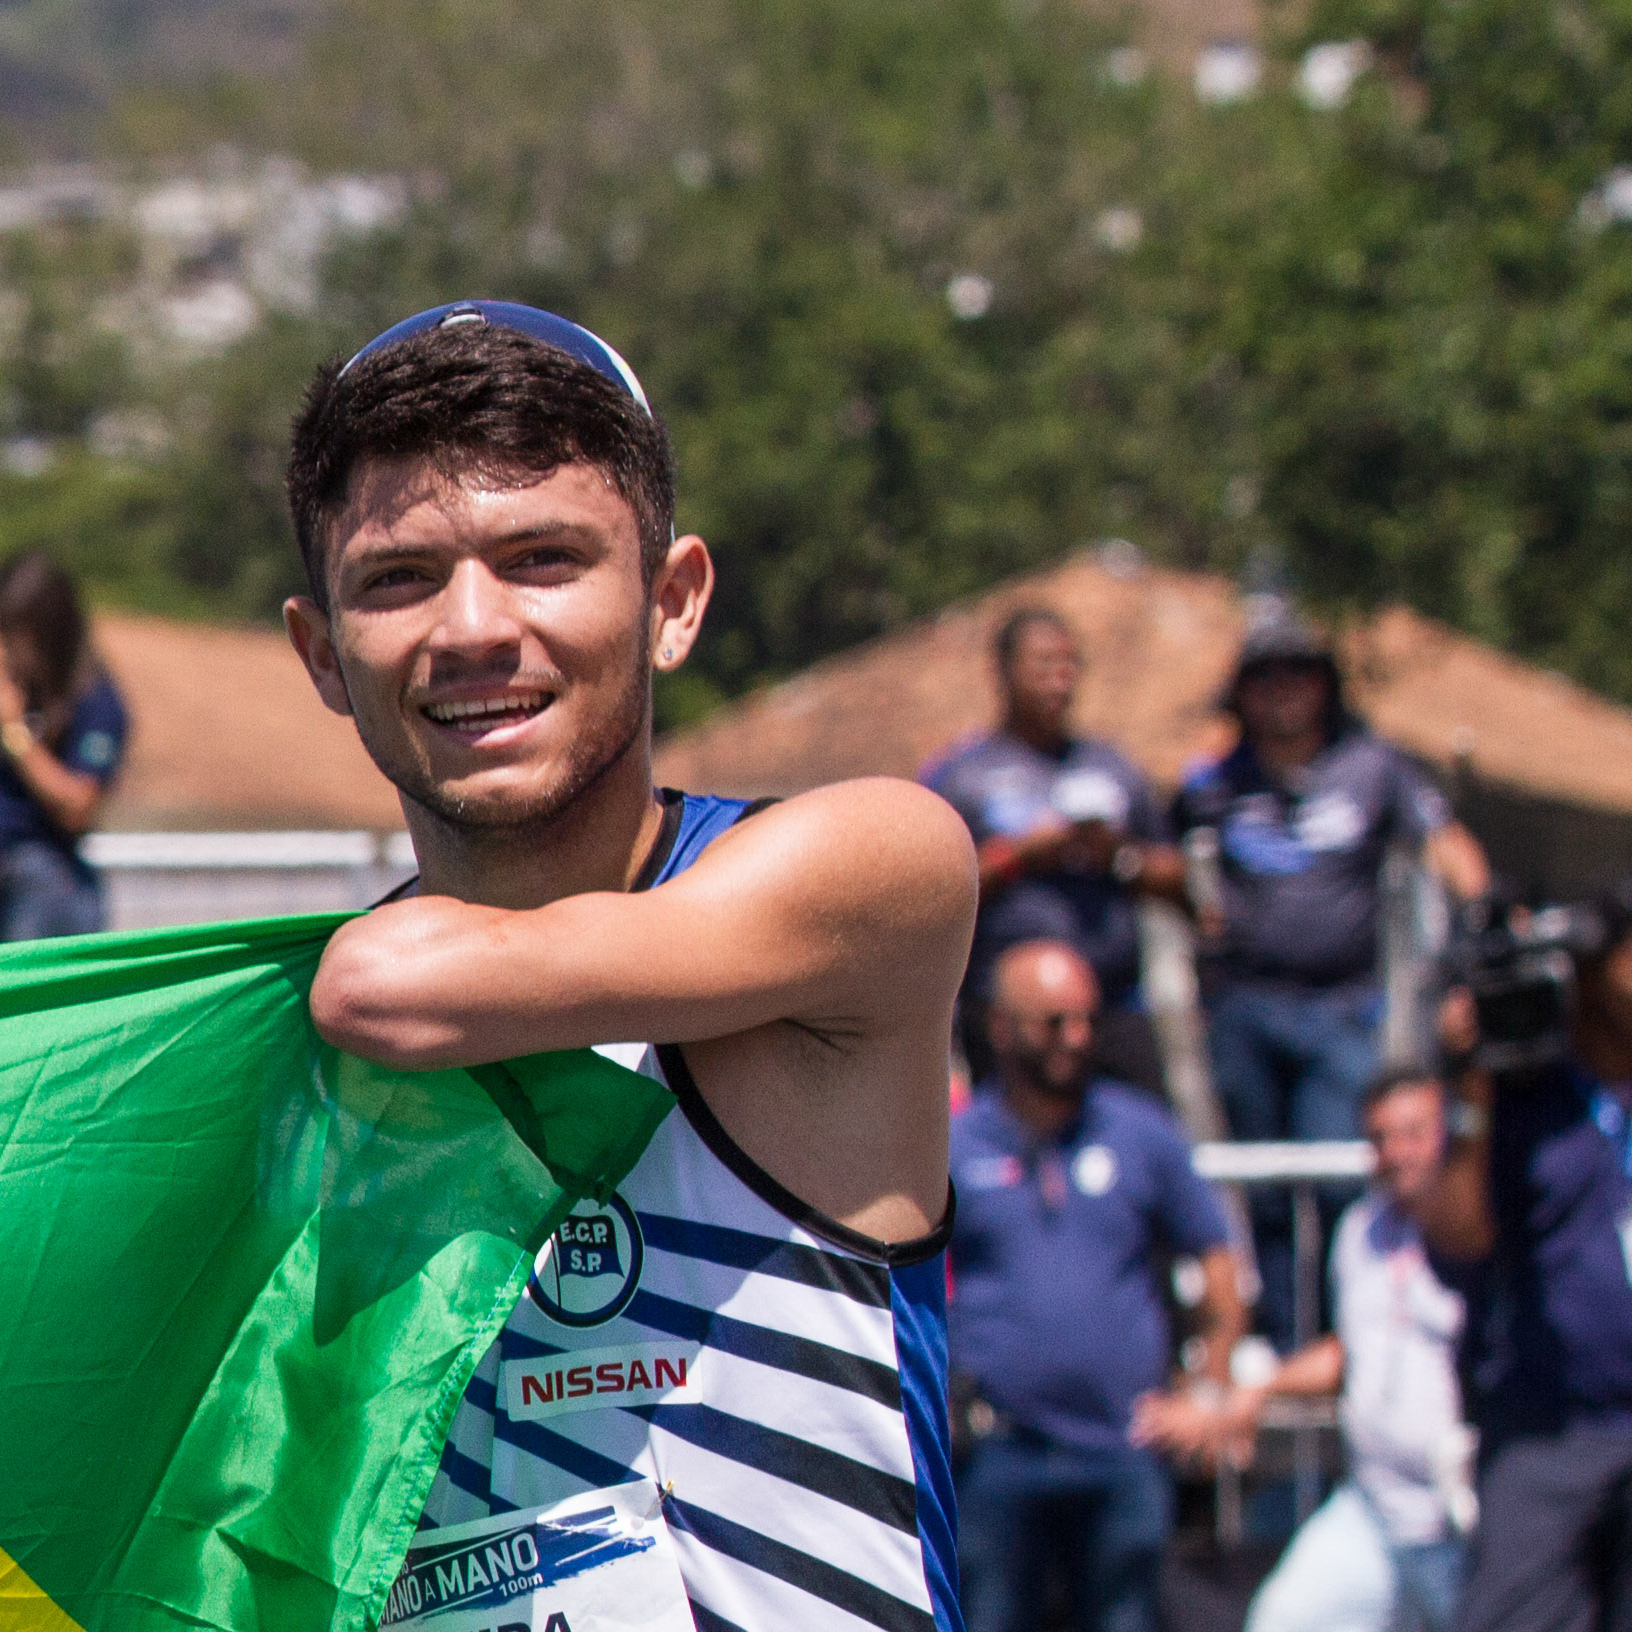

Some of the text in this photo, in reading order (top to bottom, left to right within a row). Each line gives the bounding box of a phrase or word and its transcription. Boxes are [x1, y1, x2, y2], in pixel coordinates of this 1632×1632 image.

[521, 1357, 688, 1405] NISSAN
[424, 1576, 436, 1602] A
[435, 1532, 539, 1602] MANO
[498, 1571, 544, 1598] 100m
